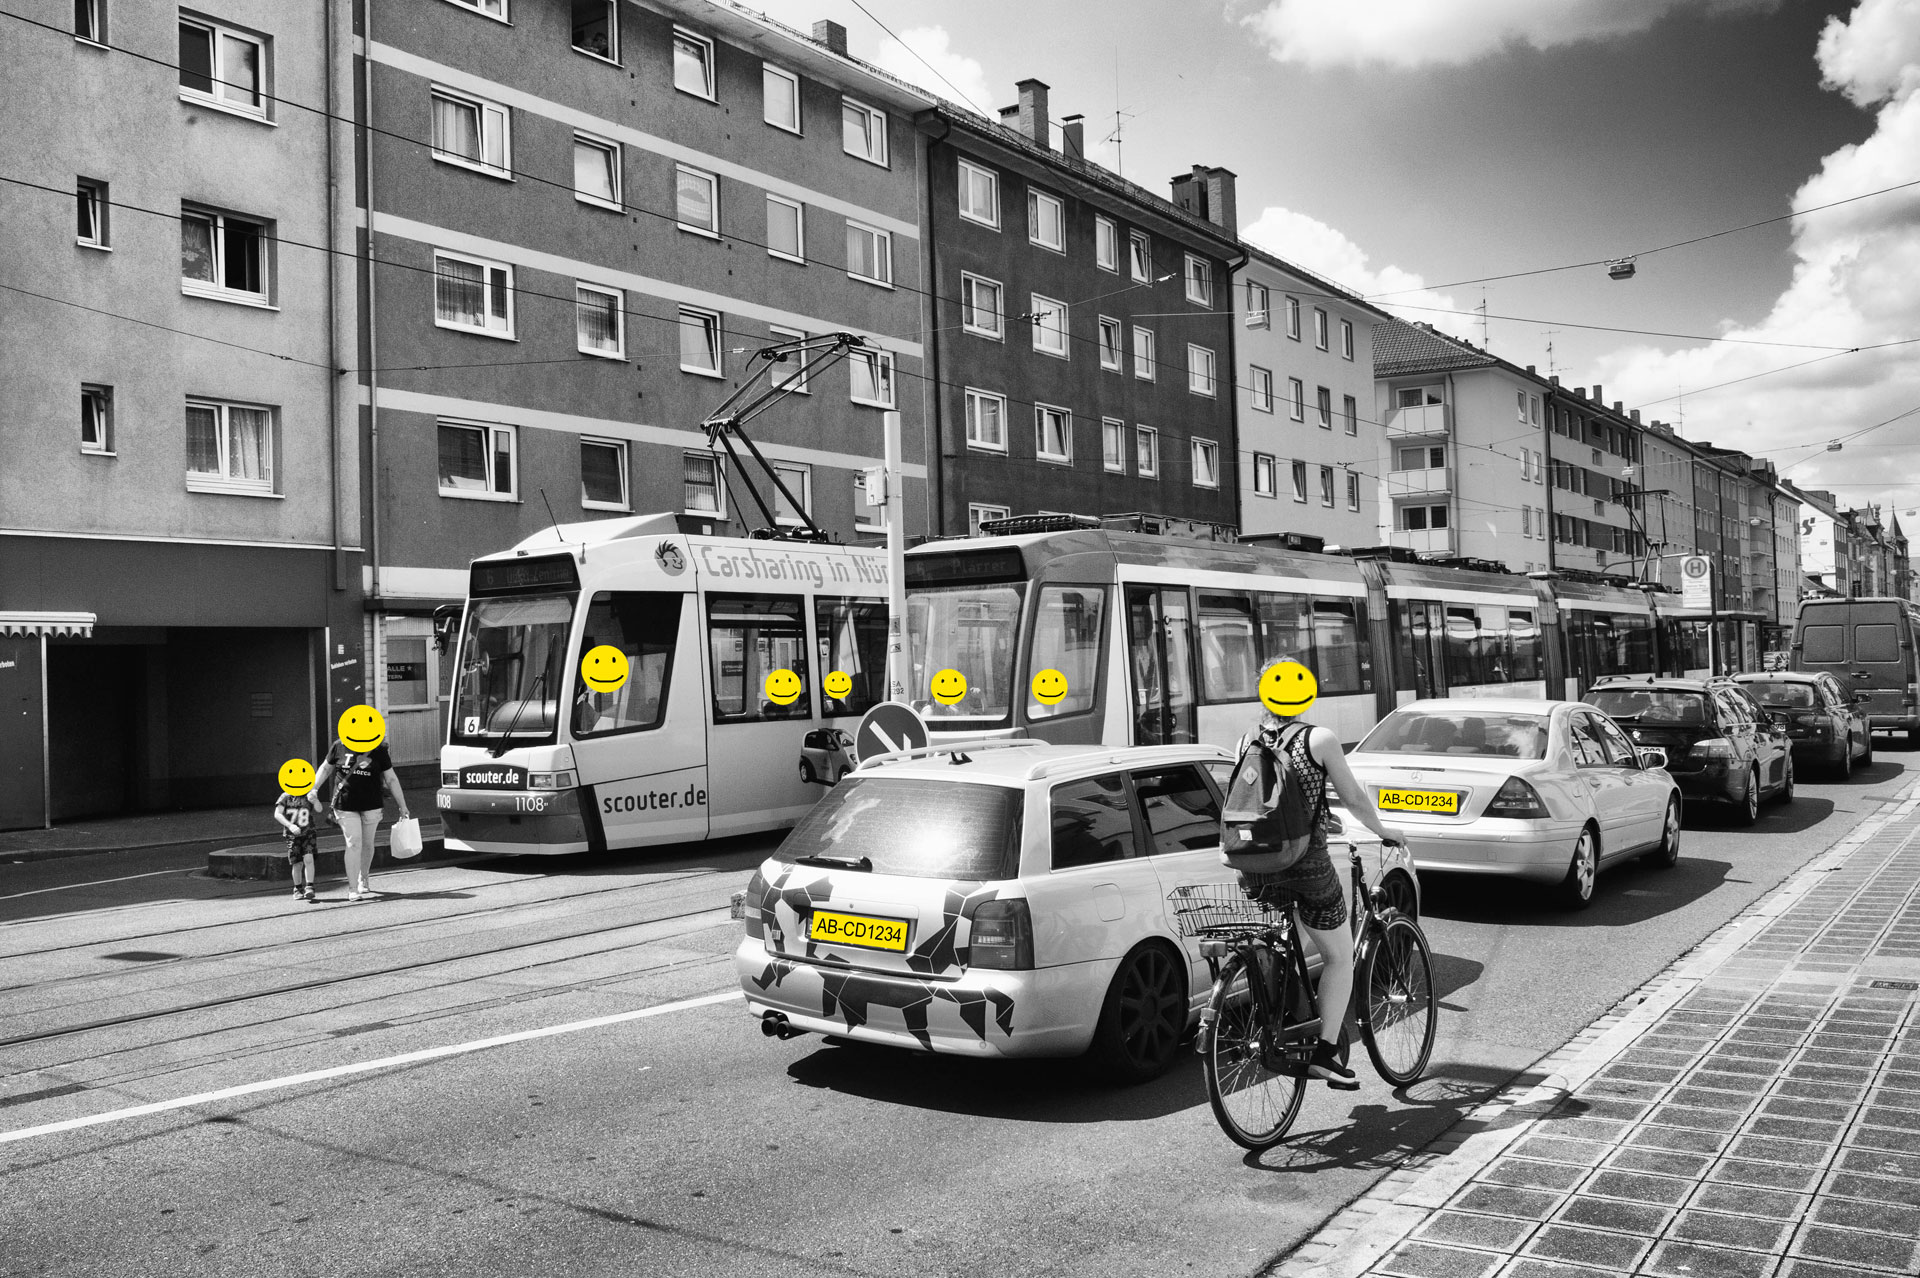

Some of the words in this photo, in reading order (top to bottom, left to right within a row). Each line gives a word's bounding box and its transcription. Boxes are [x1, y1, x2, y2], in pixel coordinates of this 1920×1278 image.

[701, 546, 824, 589] Carsharing
[826, 555, 850, 582] in
[1690, 562, 1701, 574] H
[468, 719, 475, 733] 6
[466, 768, 519, 785] scouter.de
[515, 797, 544, 812] 1108
[603, 783, 706, 814] scouter.de
[286, 807, 310, 827] 78
